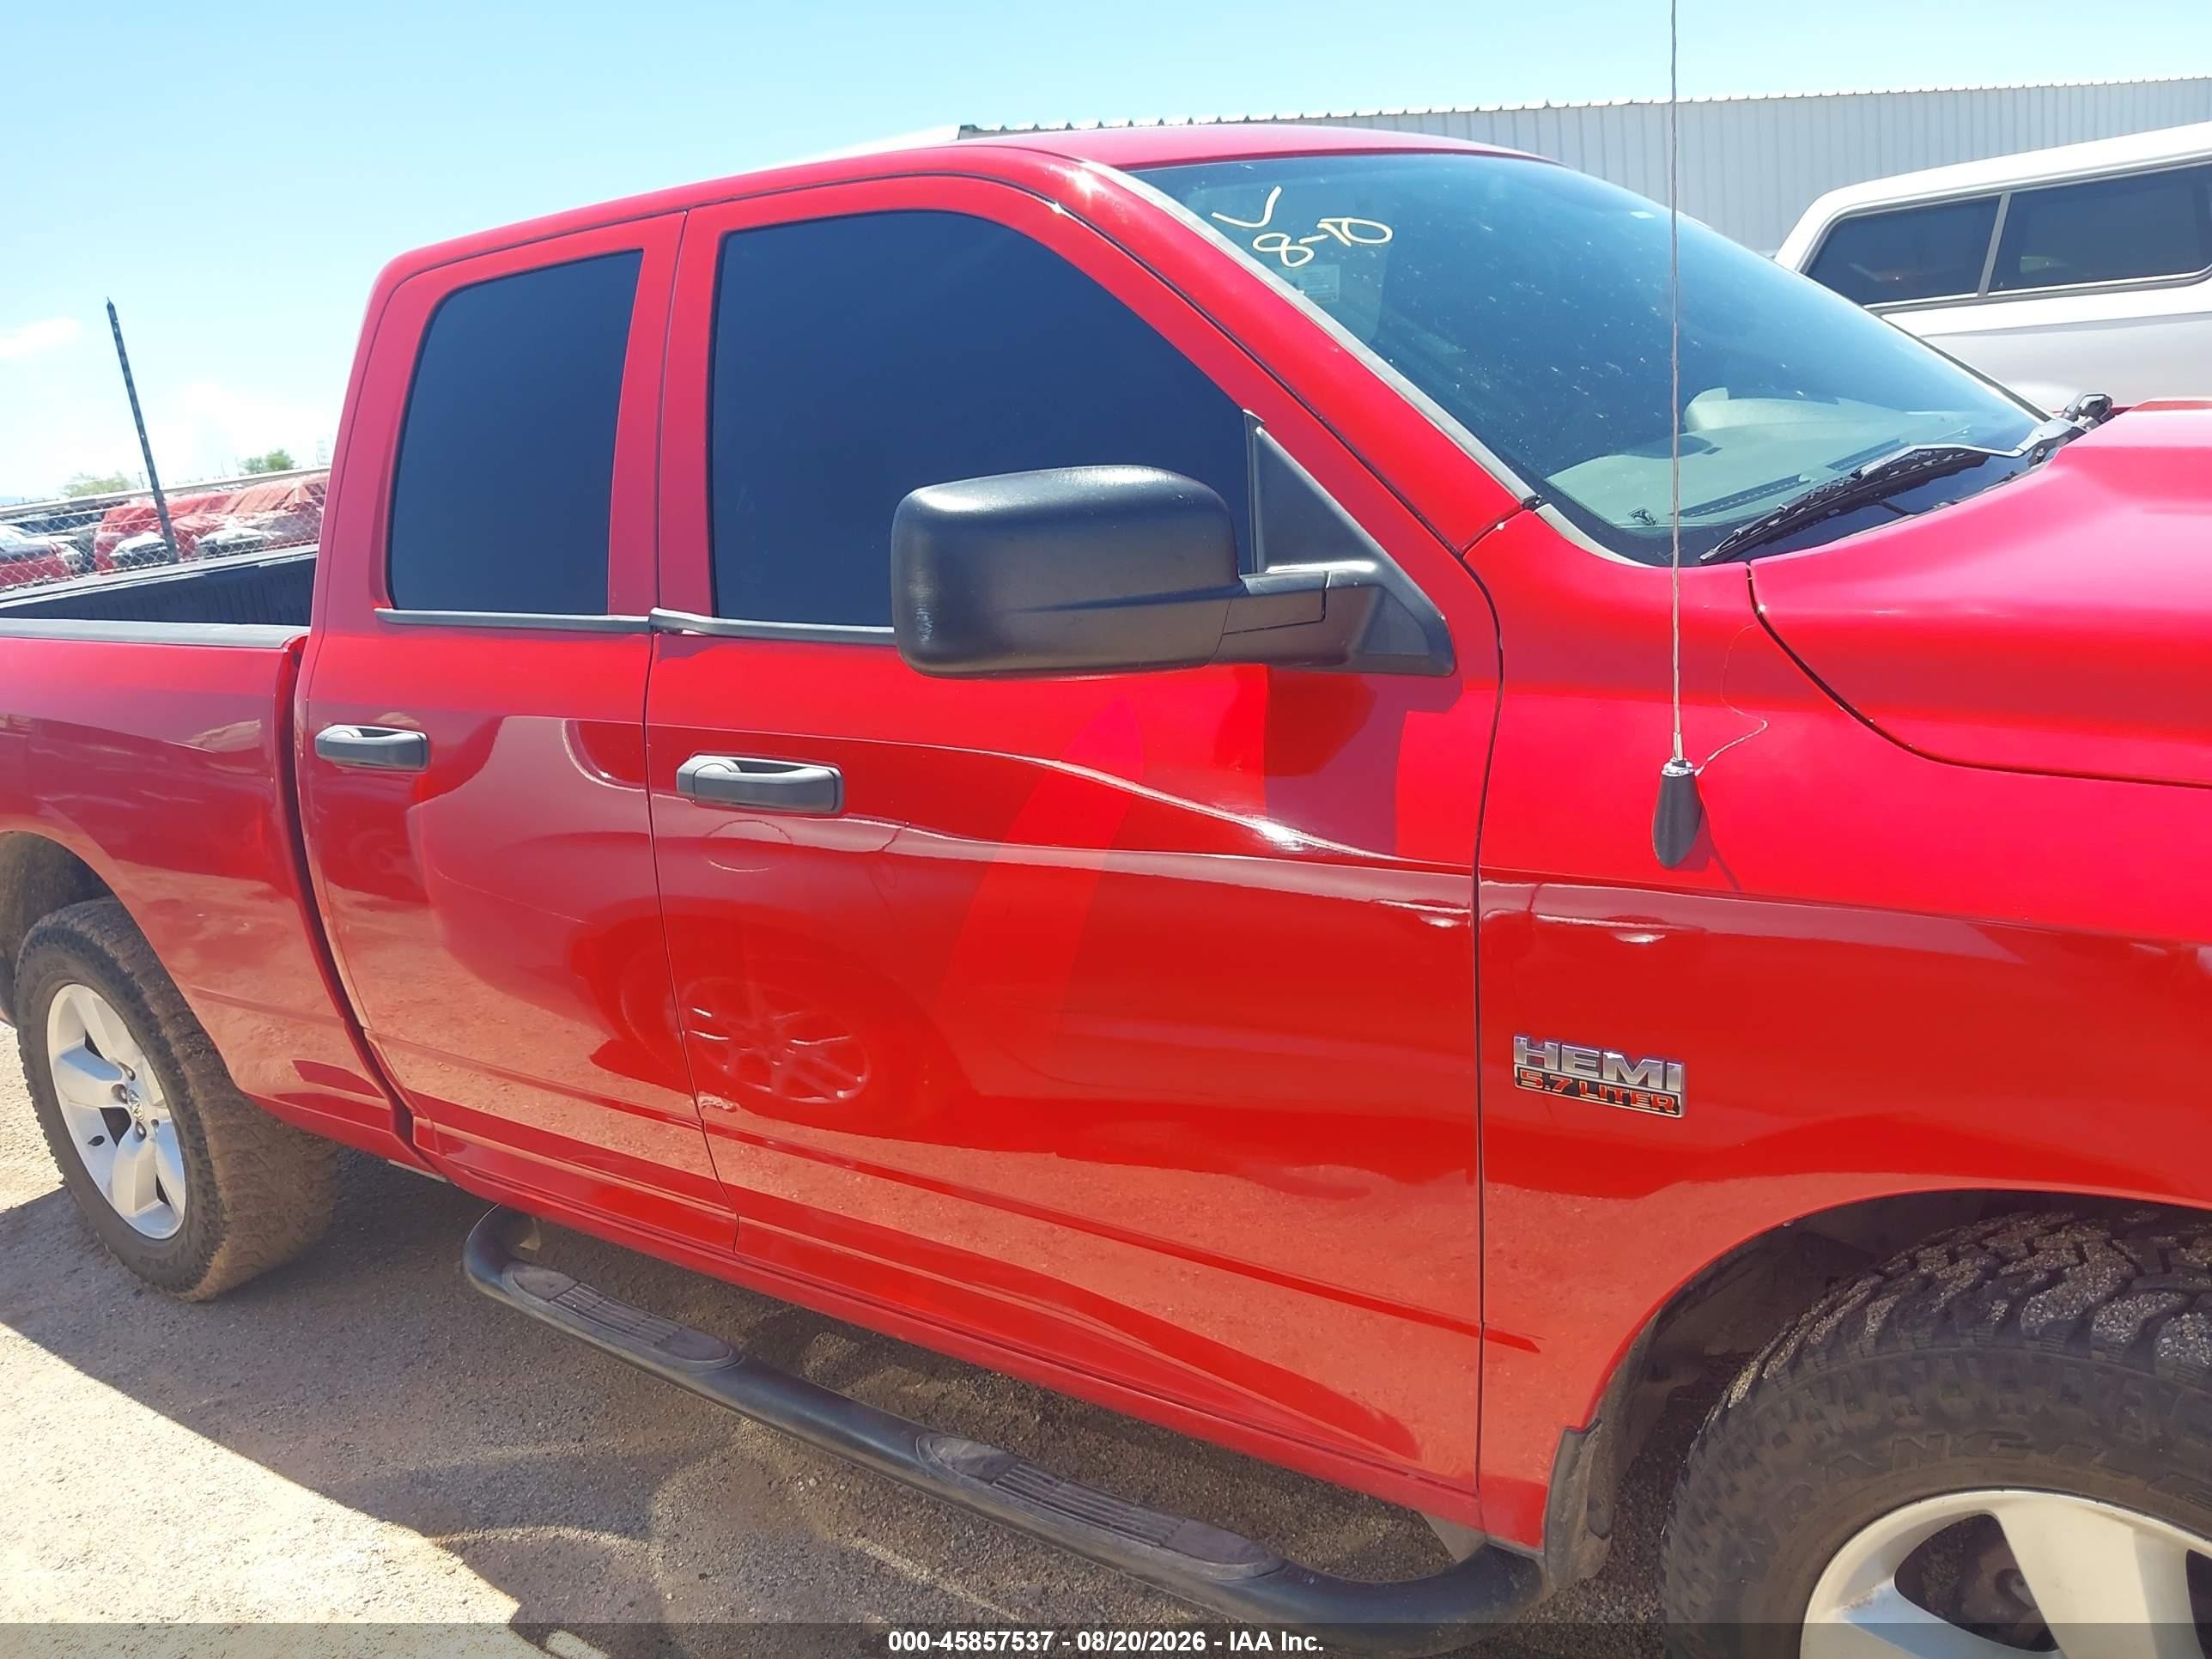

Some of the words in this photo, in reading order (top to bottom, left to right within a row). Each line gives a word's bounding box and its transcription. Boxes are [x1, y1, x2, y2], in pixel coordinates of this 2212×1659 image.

[1513, 1036, 1685, 1092] HEMI
[1520, 1069, 1572, 1092] 5.7
[1579, 1080, 1675, 1113] LITER
